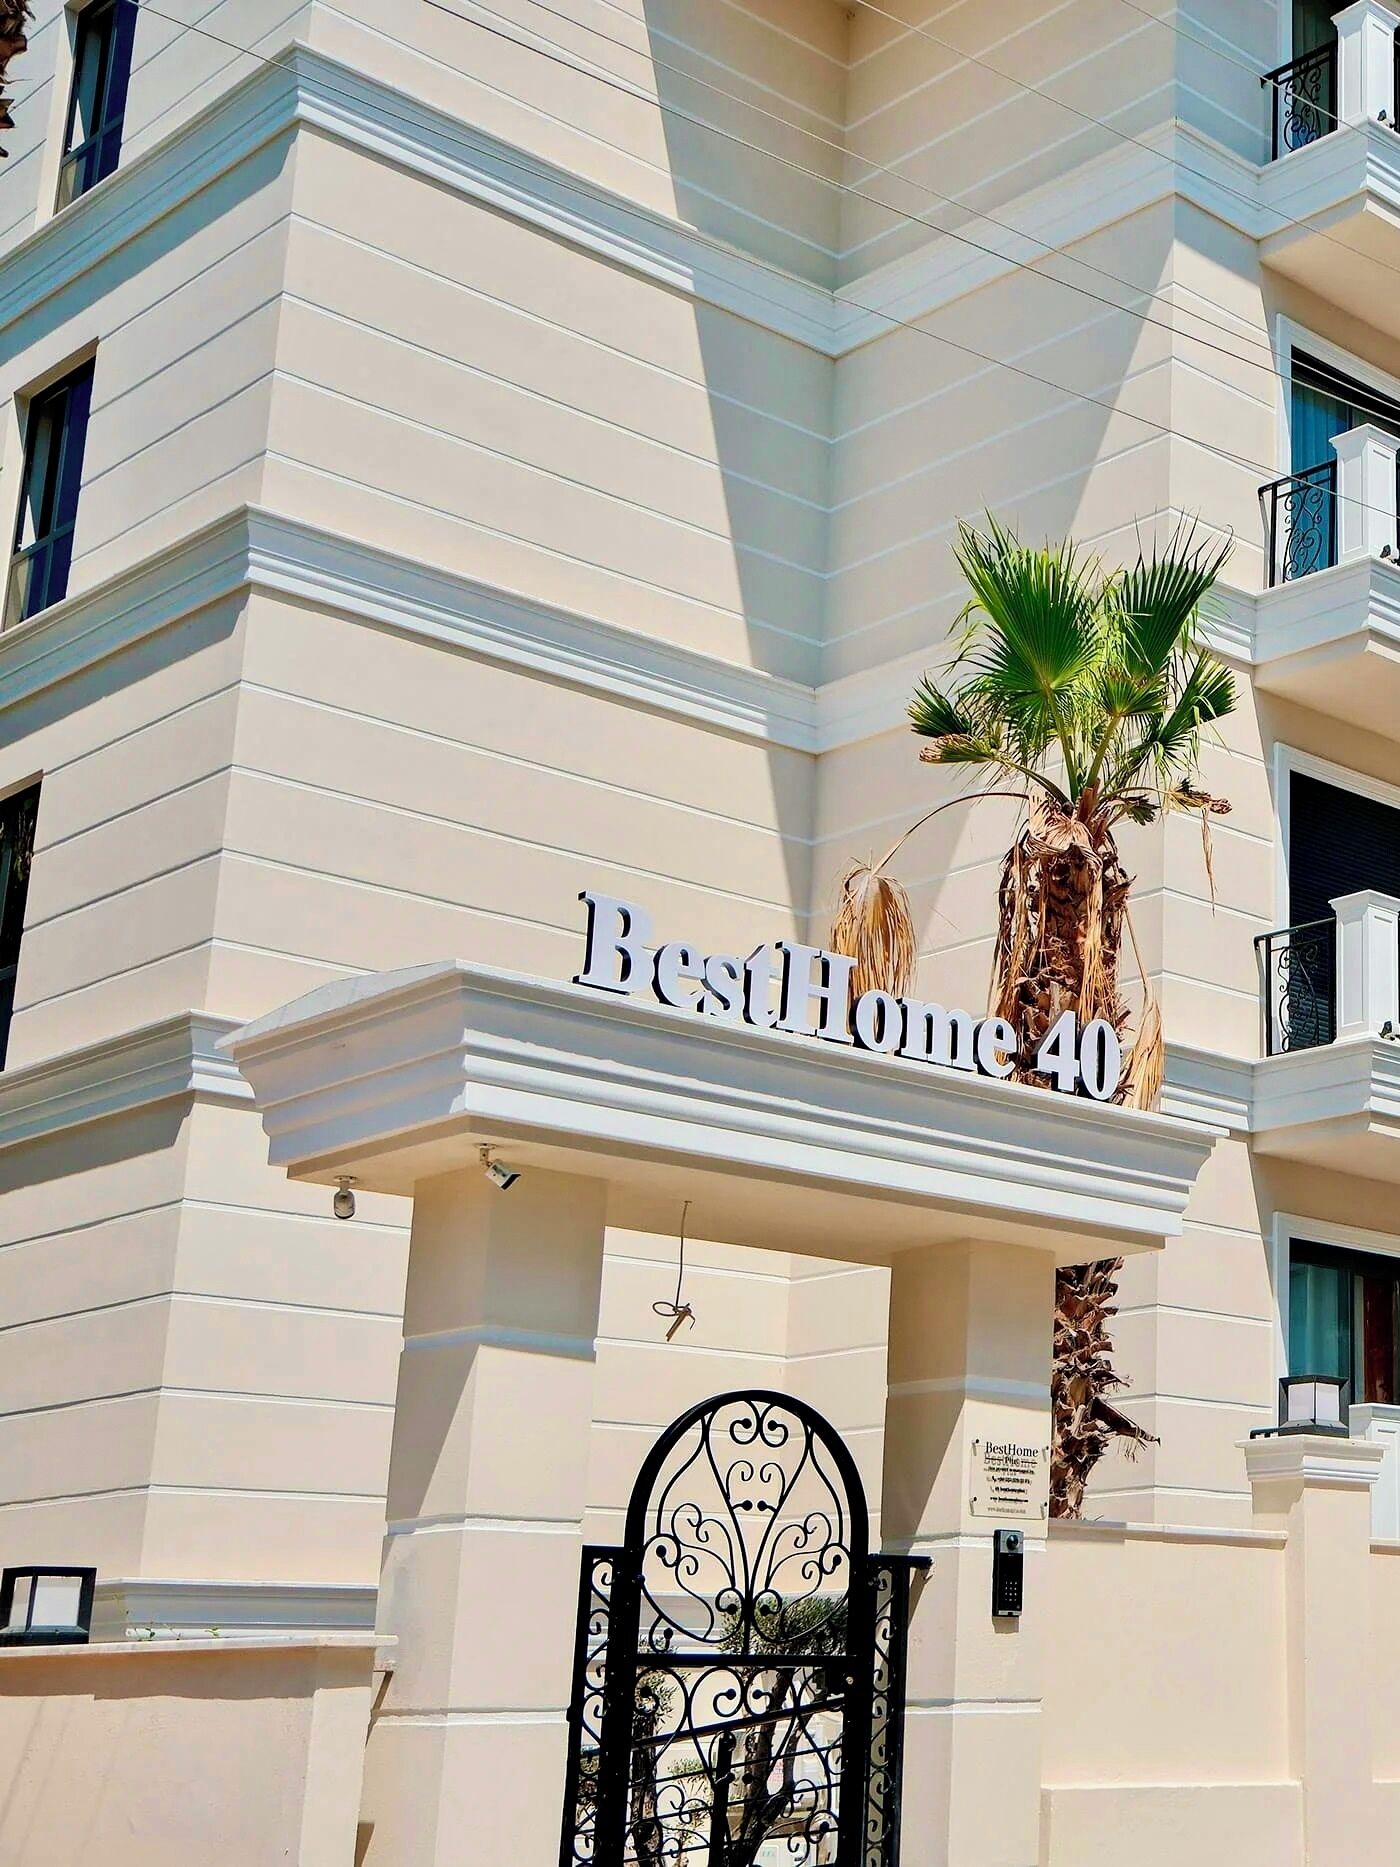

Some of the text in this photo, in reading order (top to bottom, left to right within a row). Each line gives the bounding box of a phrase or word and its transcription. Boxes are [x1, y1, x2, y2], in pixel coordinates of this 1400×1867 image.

[573, 890, 1121, 1101] BestHome 40
[985, 1441, 1039, 1457] BestHome
